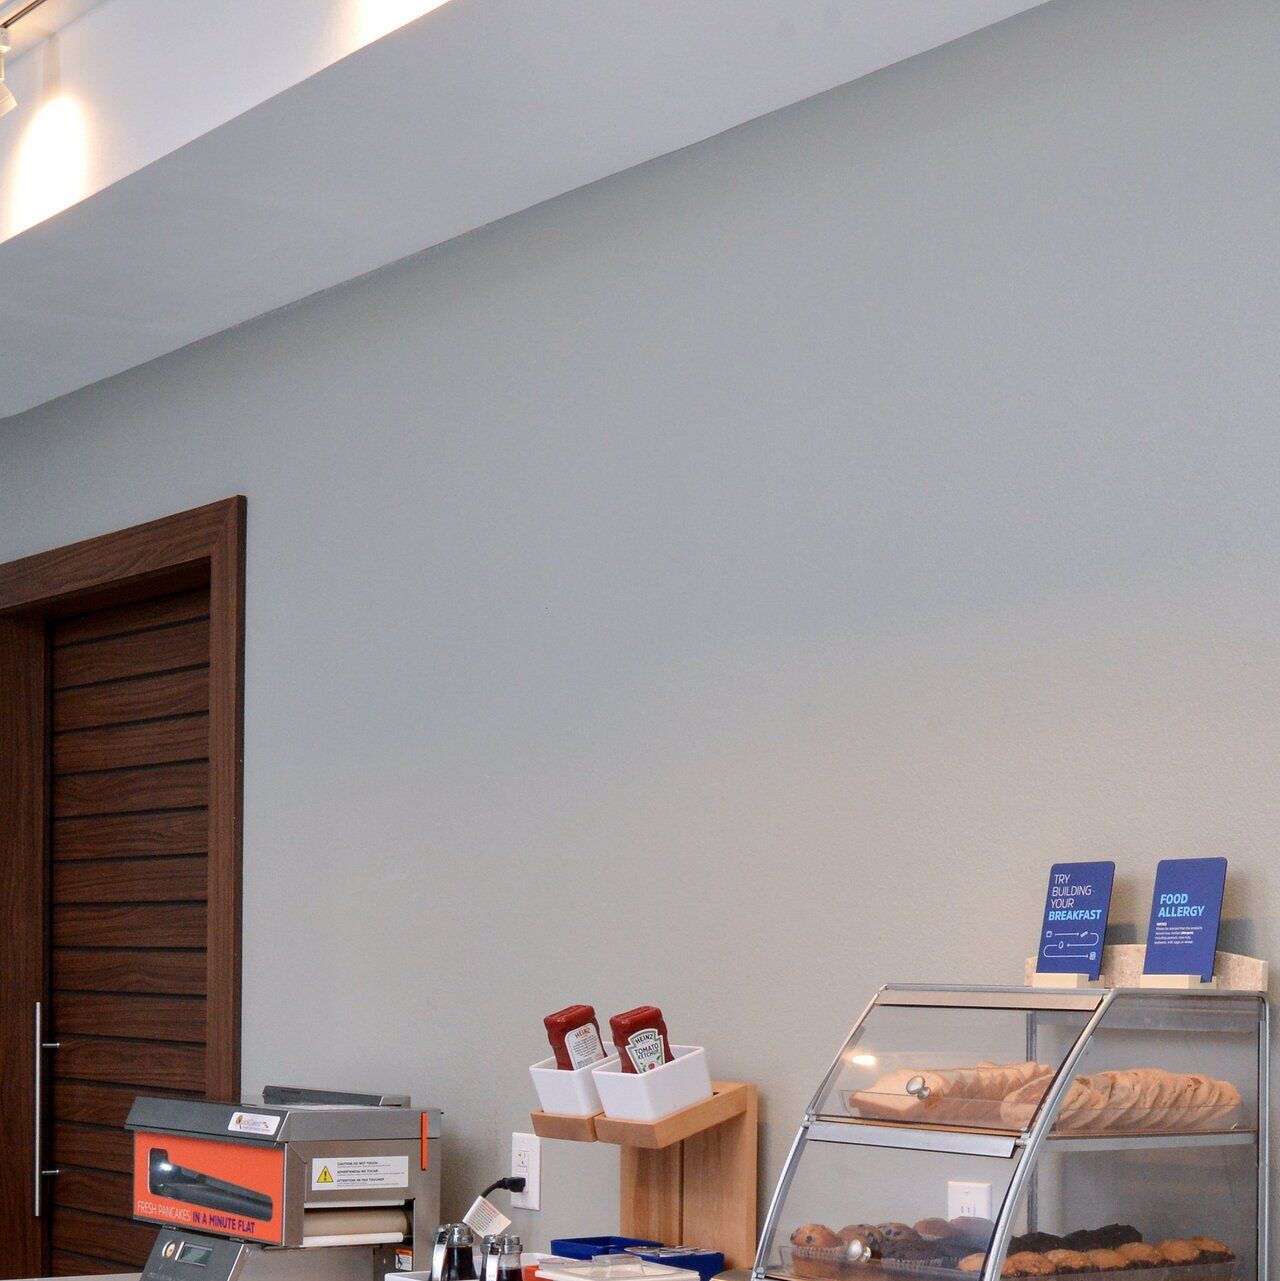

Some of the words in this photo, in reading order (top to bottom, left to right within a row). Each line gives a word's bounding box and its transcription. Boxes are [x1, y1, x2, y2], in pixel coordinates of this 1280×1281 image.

[1054, 874, 1070, 884] TRY
[1052, 885, 1092, 897] BUILDING
[1051, 898, 1074, 909] YOUR
[1160, 893, 1188, 905] FOOD
[1048, 909, 1102, 921] BREAKFAST
[1158, 905, 1205, 918] ALLERGY
[635, 1033, 654, 1044] HEINZ
[634, 1043, 659, 1055] TOMATO
[638, 1049, 659, 1060] KETCHUP
[138, 1200, 157, 1215] FRESH
[158, 1203, 191, 1222] PANCAKES
[193, 1211, 200, 1223] IN
[203, 1213, 208, 1224] A
[209, 1214, 236, 1230] MINUTE
[238, 1219, 256, 1234] FLAT
